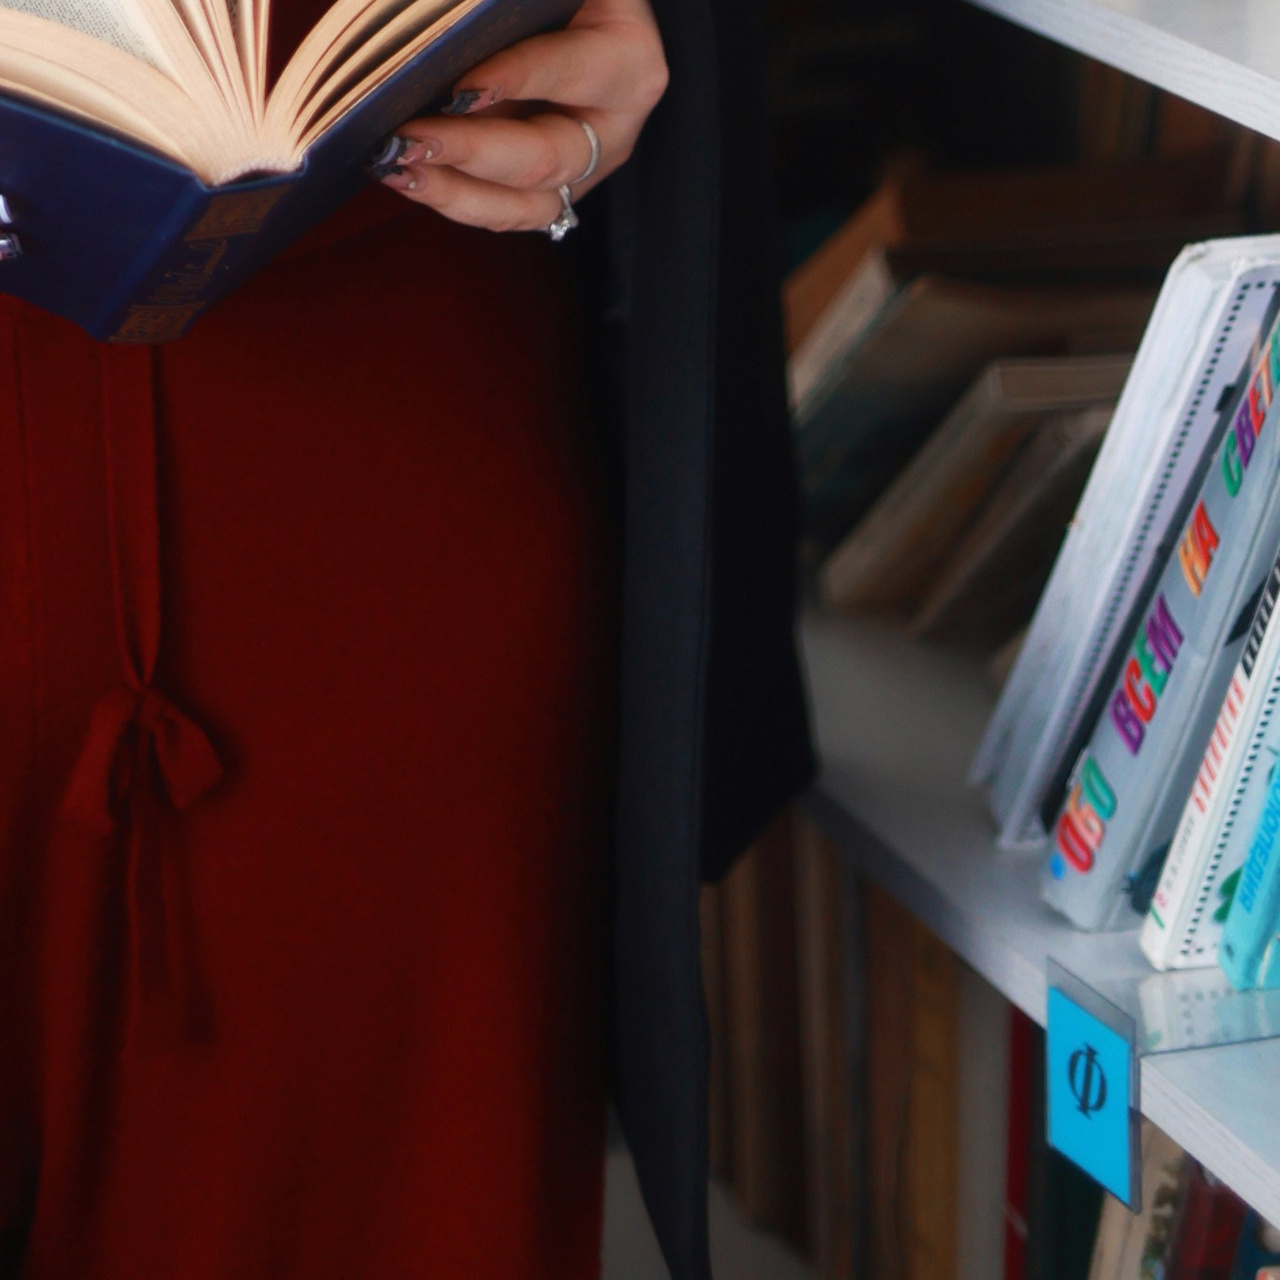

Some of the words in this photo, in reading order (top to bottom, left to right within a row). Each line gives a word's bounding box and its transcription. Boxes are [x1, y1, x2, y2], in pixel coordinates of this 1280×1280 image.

[1056, 755, 1118, 875] ОБО
[1111, 593, 1185, 757] ВСЕМ
[1179, 499, 1221, 598] НА
[1067, 1042, 1108, 1120] Ф
